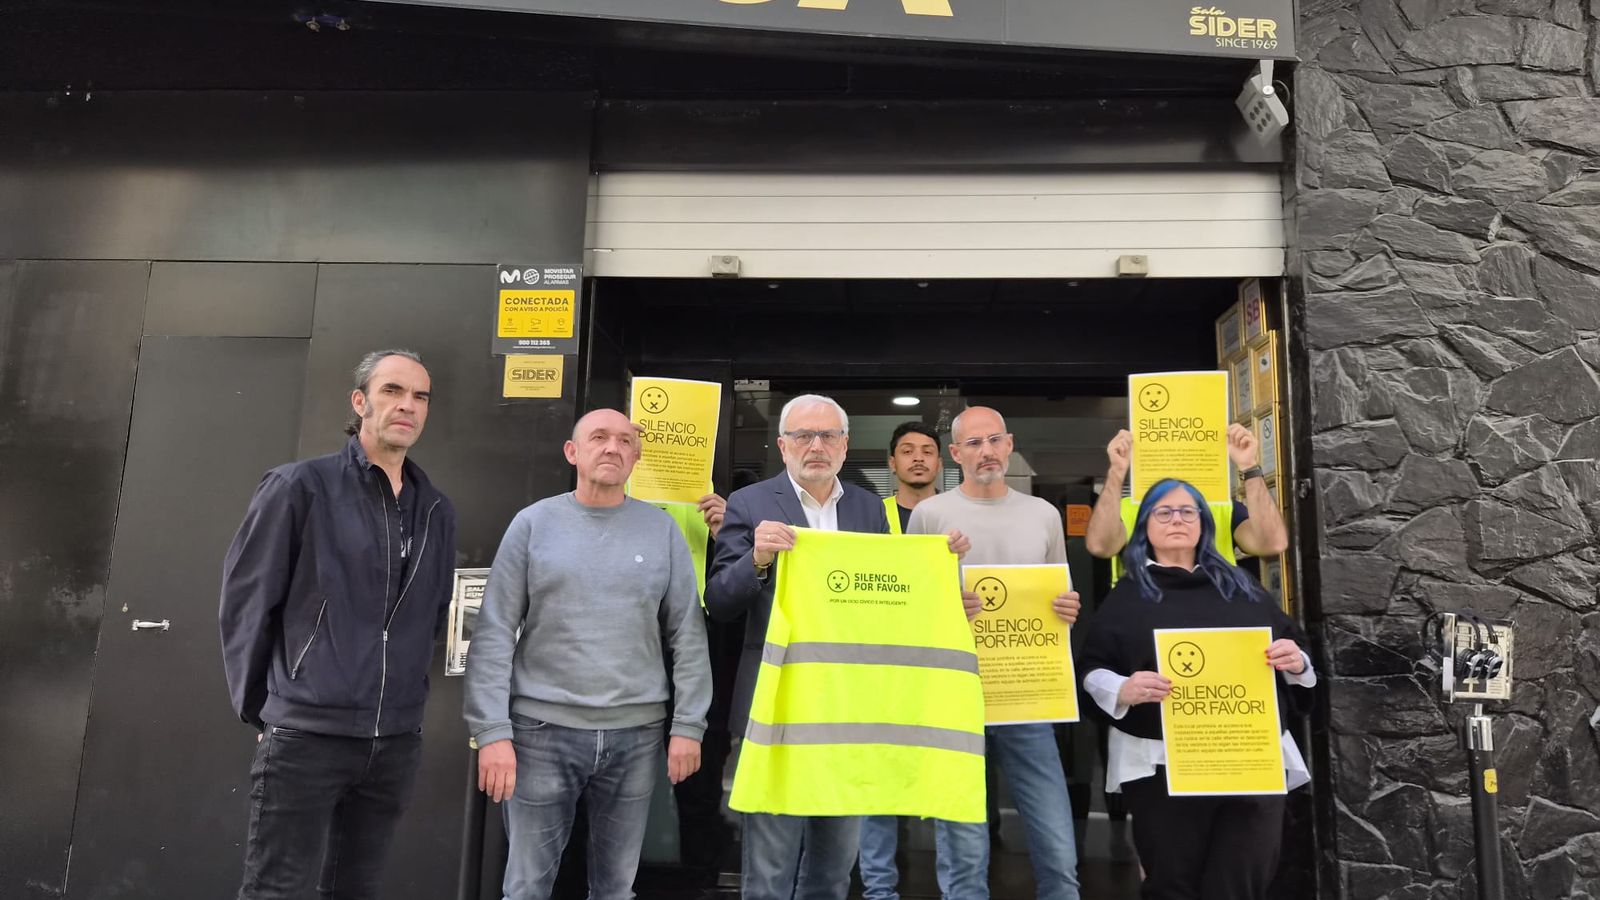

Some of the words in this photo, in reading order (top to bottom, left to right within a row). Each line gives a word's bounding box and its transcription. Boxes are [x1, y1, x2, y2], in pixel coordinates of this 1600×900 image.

[1189, 15, 1278, 39] SIDER
[1215, 37, 1249, 49] SINCE
[1251, 39, 1278, 50] 1969
[505, 297, 569, 306] CONECTADA
[511, 369, 557, 381] SIDER
[639, 418, 696, 435] SILENCIO
[1139, 417, 1204, 430] SILENCIO
[638, 431, 665, 444] POR
[666, 434, 708, 448] FAVOR!
[1139, 431, 1170, 443] POR
[1171, 430, 1219, 442] FAVOR!
[854, 573, 898, 583] SILENCIO
[854, 582, 874, 592] POR
[876, 583, 911, 593] FAVOR!
[974, 617, 1044, 633] SILENCIO
[975, 635, 1007, 649] POR
[1009, 632, 1059, 647] FAVOR!
[1170, 684, 1246, 700] SILENCIO
[1172, 702, 1207, 715] POR
[1209, 700, 1266, 715] FAVOR!
